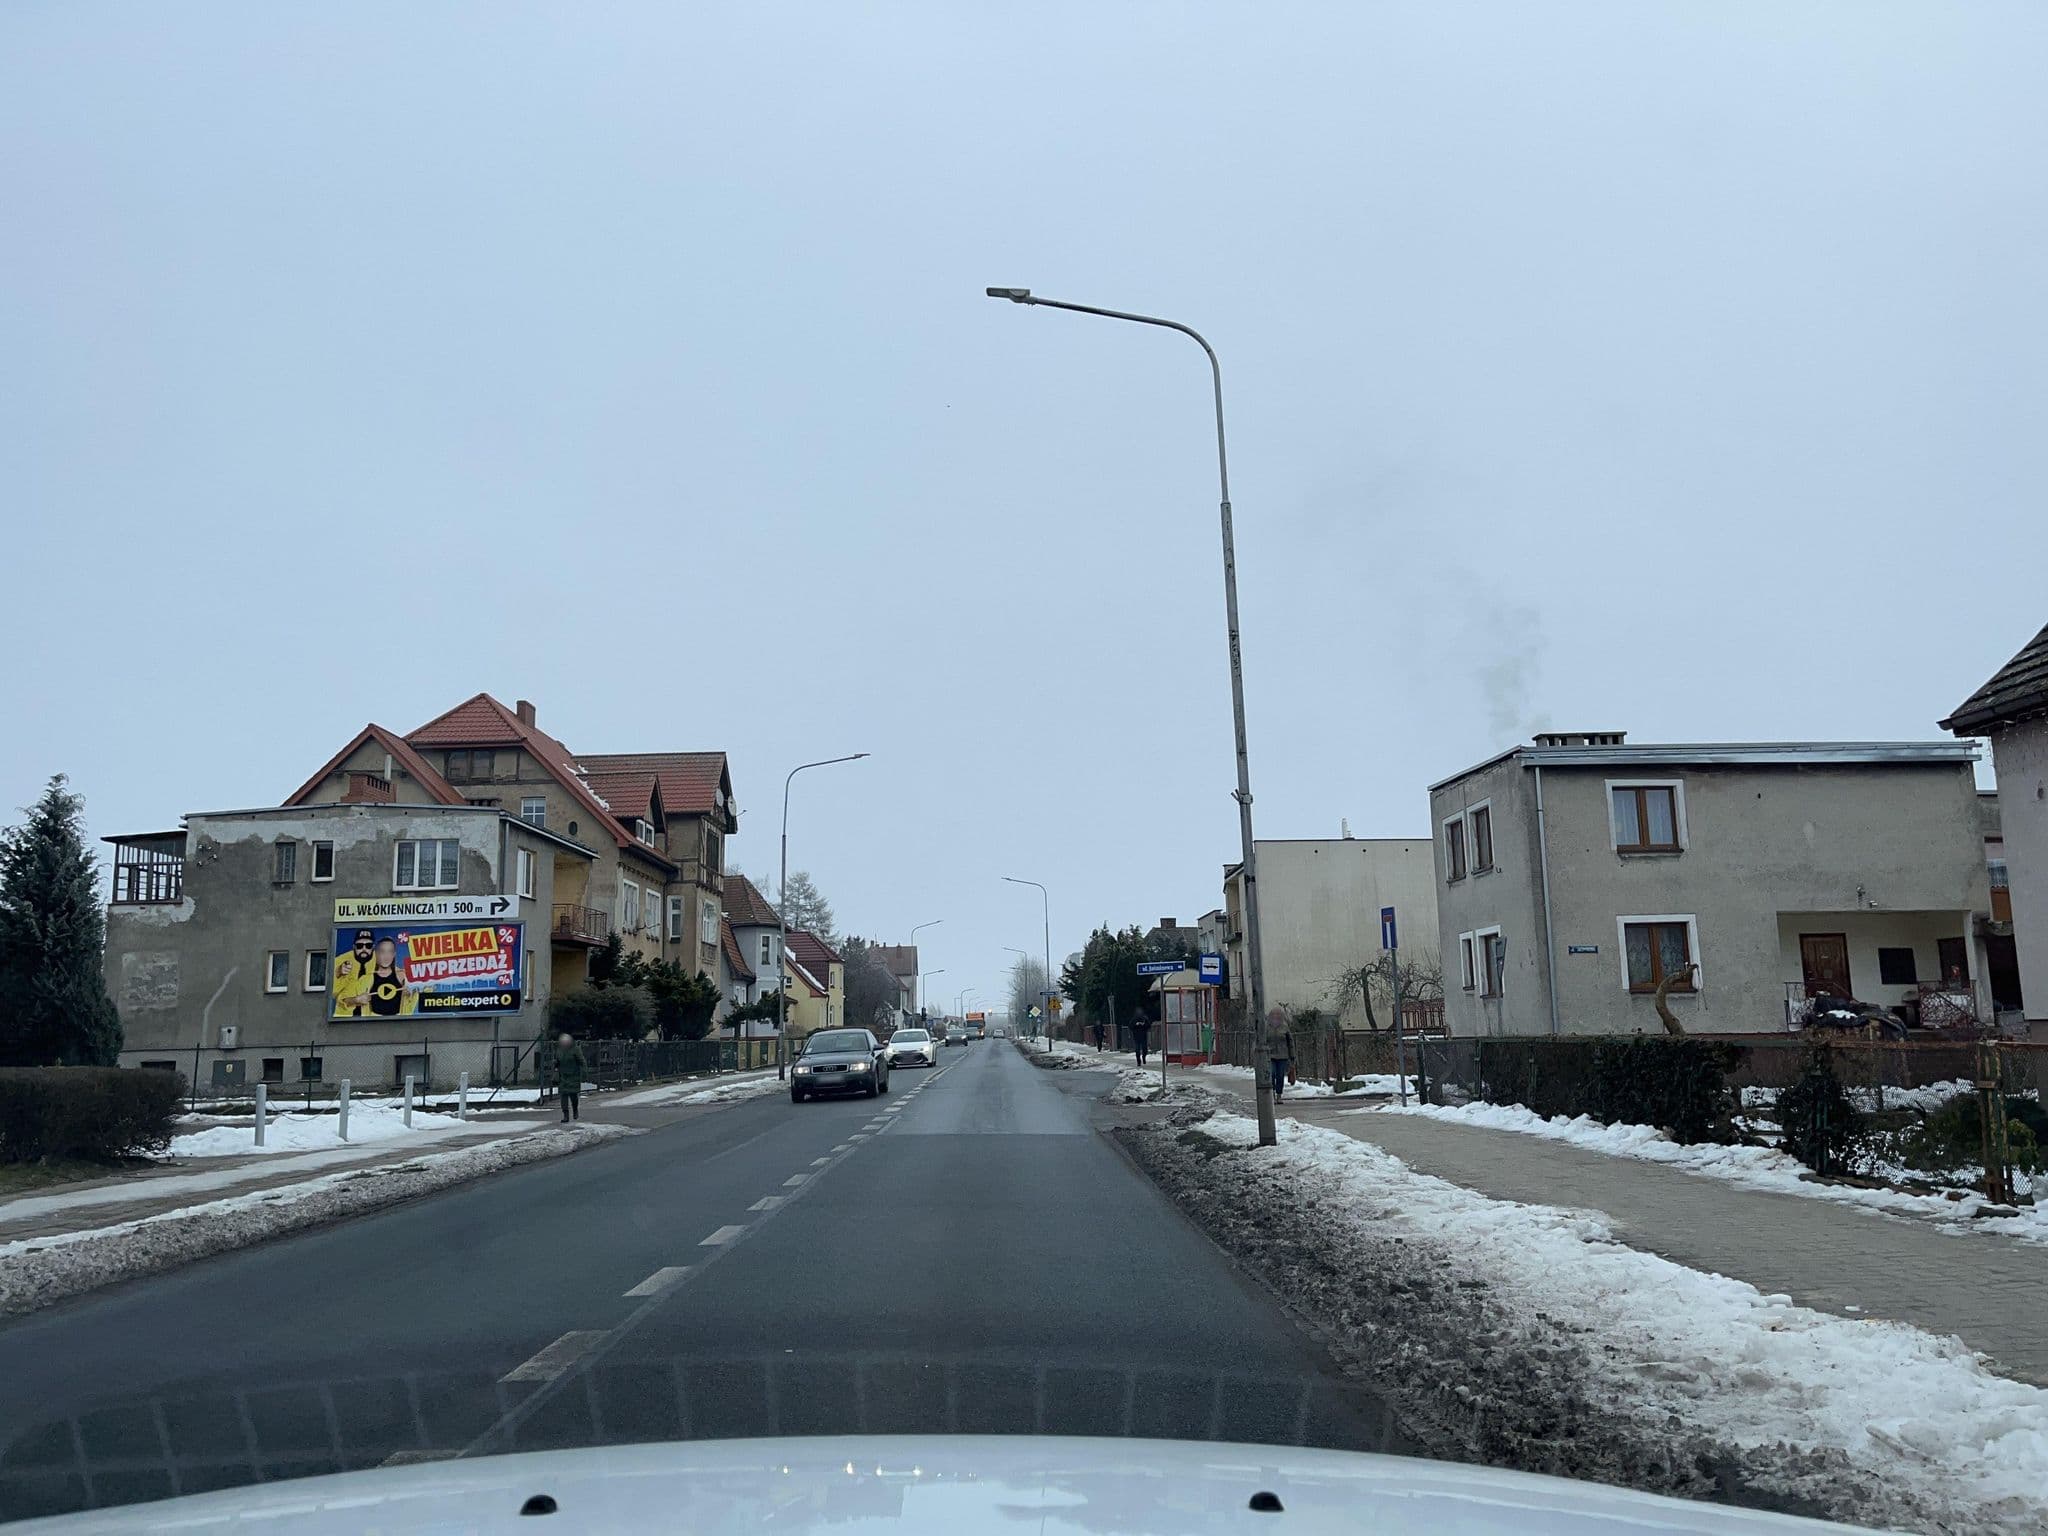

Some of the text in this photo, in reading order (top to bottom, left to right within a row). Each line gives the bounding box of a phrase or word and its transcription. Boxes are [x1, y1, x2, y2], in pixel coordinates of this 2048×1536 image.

[338, 905, 355, 916] UL.
[357, 902, 434, 916] WŁÓKIENNICZA
[437, 903, 448, 914] 11
[453, 902, 473, 914] 500
[412, 930, 494, 958] WIELKA
[410, 949, 508, 979] WYPRZEDAŻ
[424, 994, 500, 1008] mediaexpert
